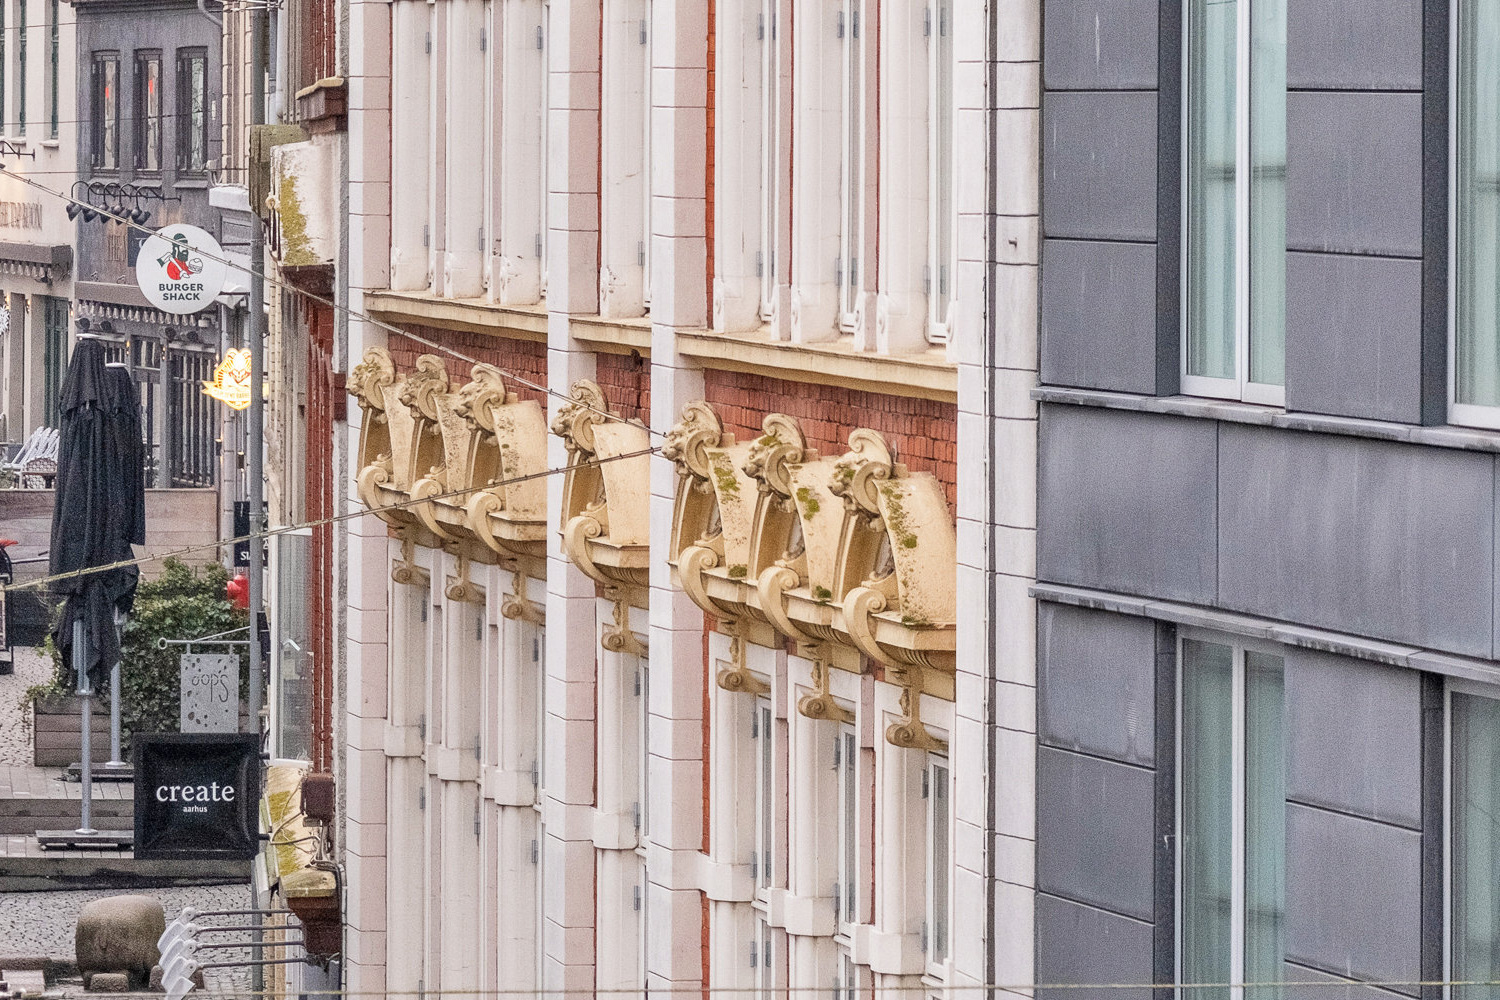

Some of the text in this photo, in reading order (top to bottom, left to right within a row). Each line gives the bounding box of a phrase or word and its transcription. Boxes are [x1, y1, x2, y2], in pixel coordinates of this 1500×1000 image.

[158, 283, 204, 292] BURGER
[162, 292, 201, 301] SHACK
[156, 781, 235, 802] create
[182, 805, 208, 813] aarhus
